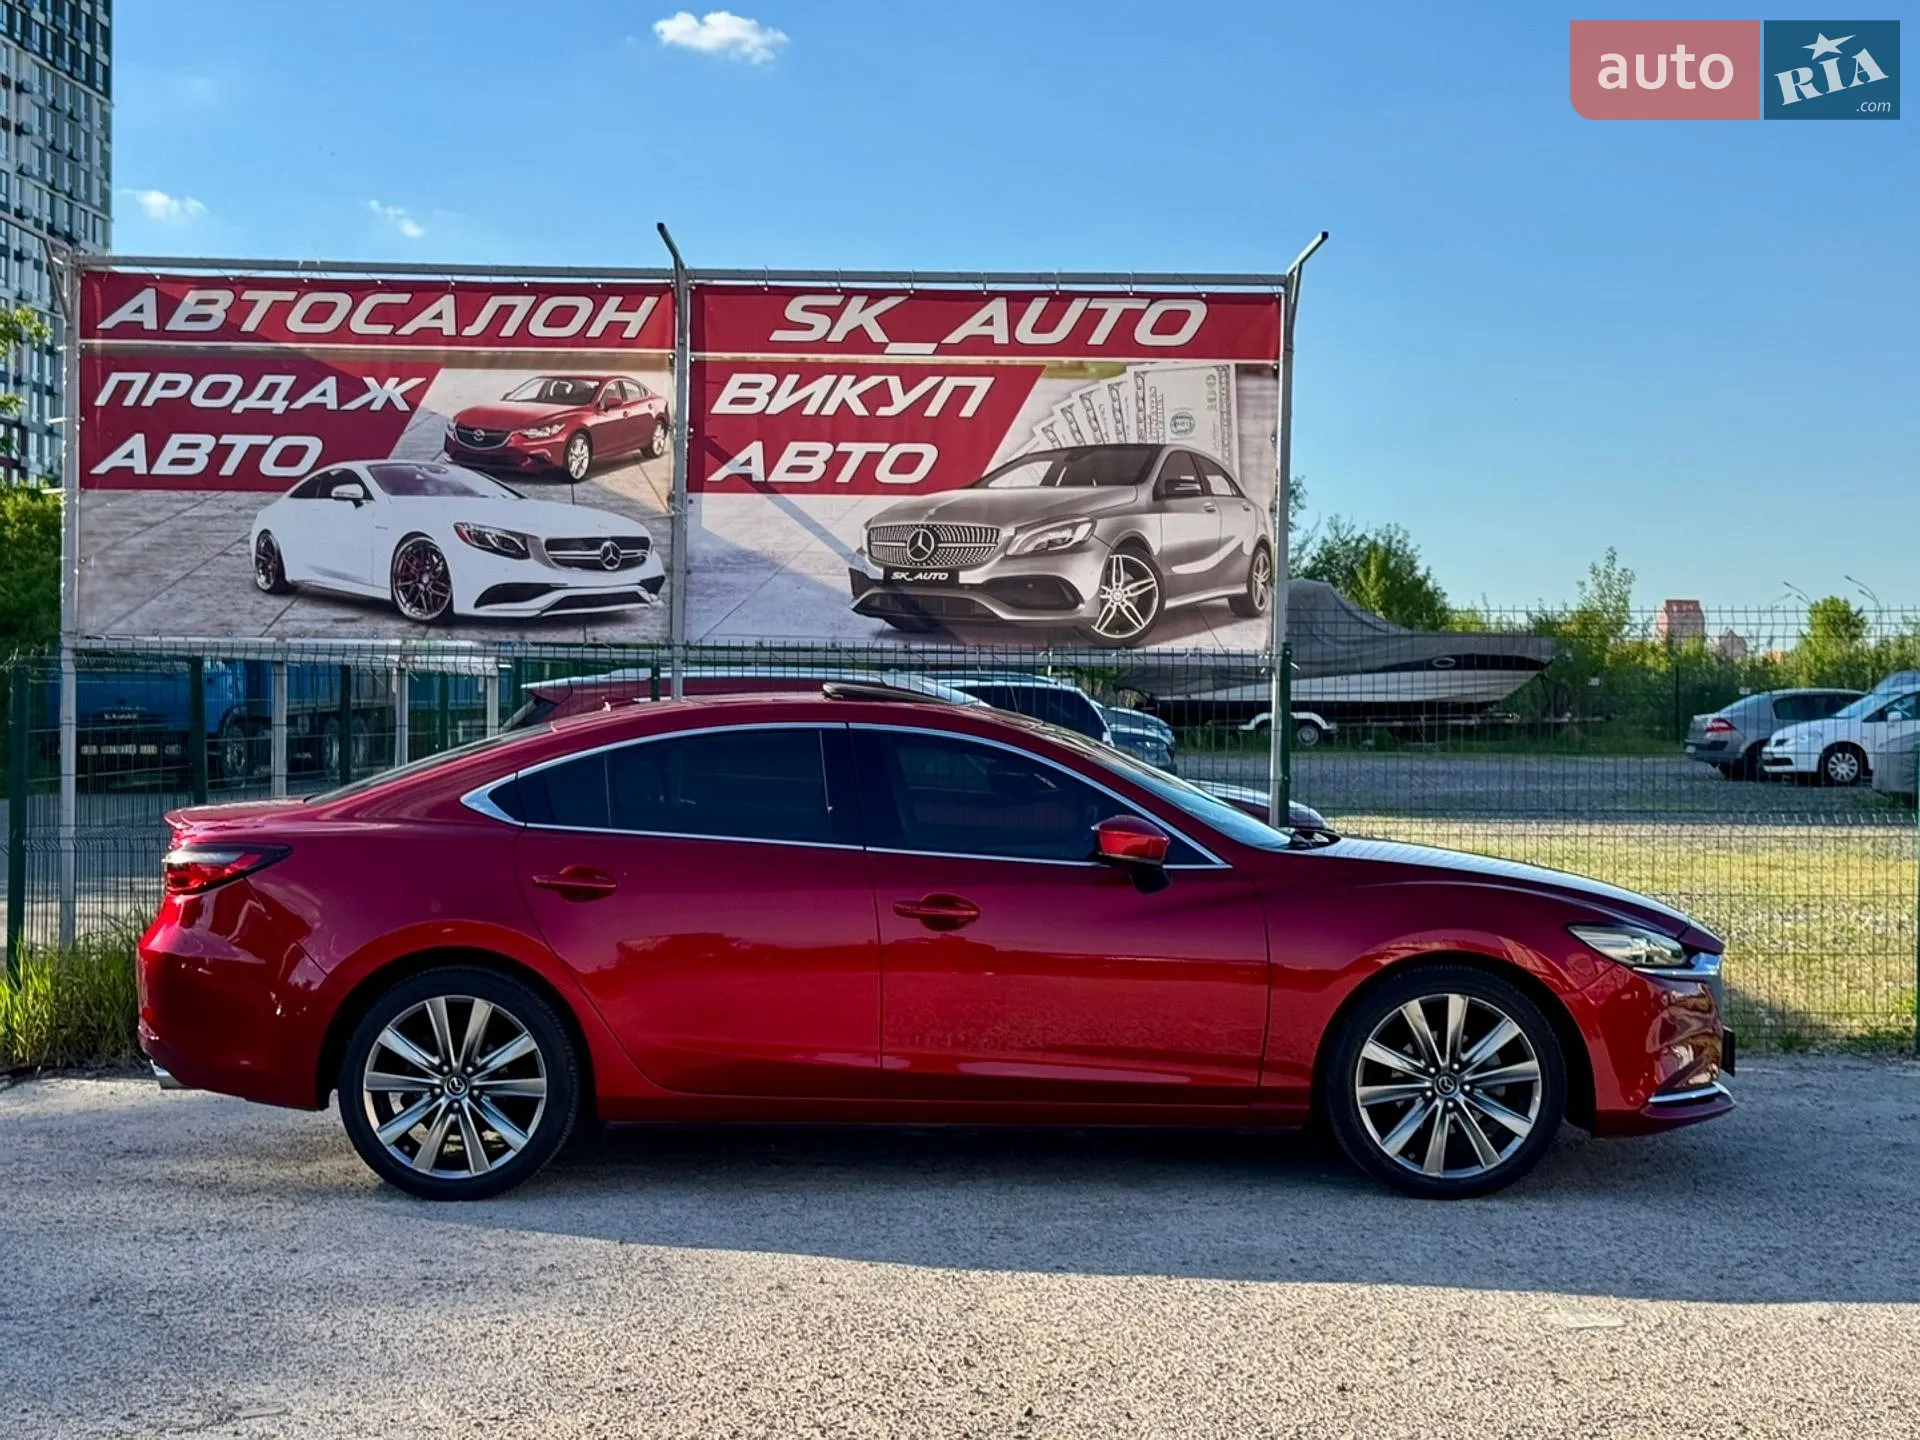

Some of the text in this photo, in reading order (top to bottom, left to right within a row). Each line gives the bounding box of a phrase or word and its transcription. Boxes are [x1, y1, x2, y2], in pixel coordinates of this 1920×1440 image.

[96, 288, 659, 339] АВТОСАЛОН
[769, 295, 1208, 355] SK_AUTO
[94, 371, 428, 415] ПРОДАЖ
[709, 373, 995, 418] ВИКУП
[90, 433, 324, 478] АВТО
[707, 440, 939, 485] АВТО
[890, 571, 949, 582] SK_AUTO
